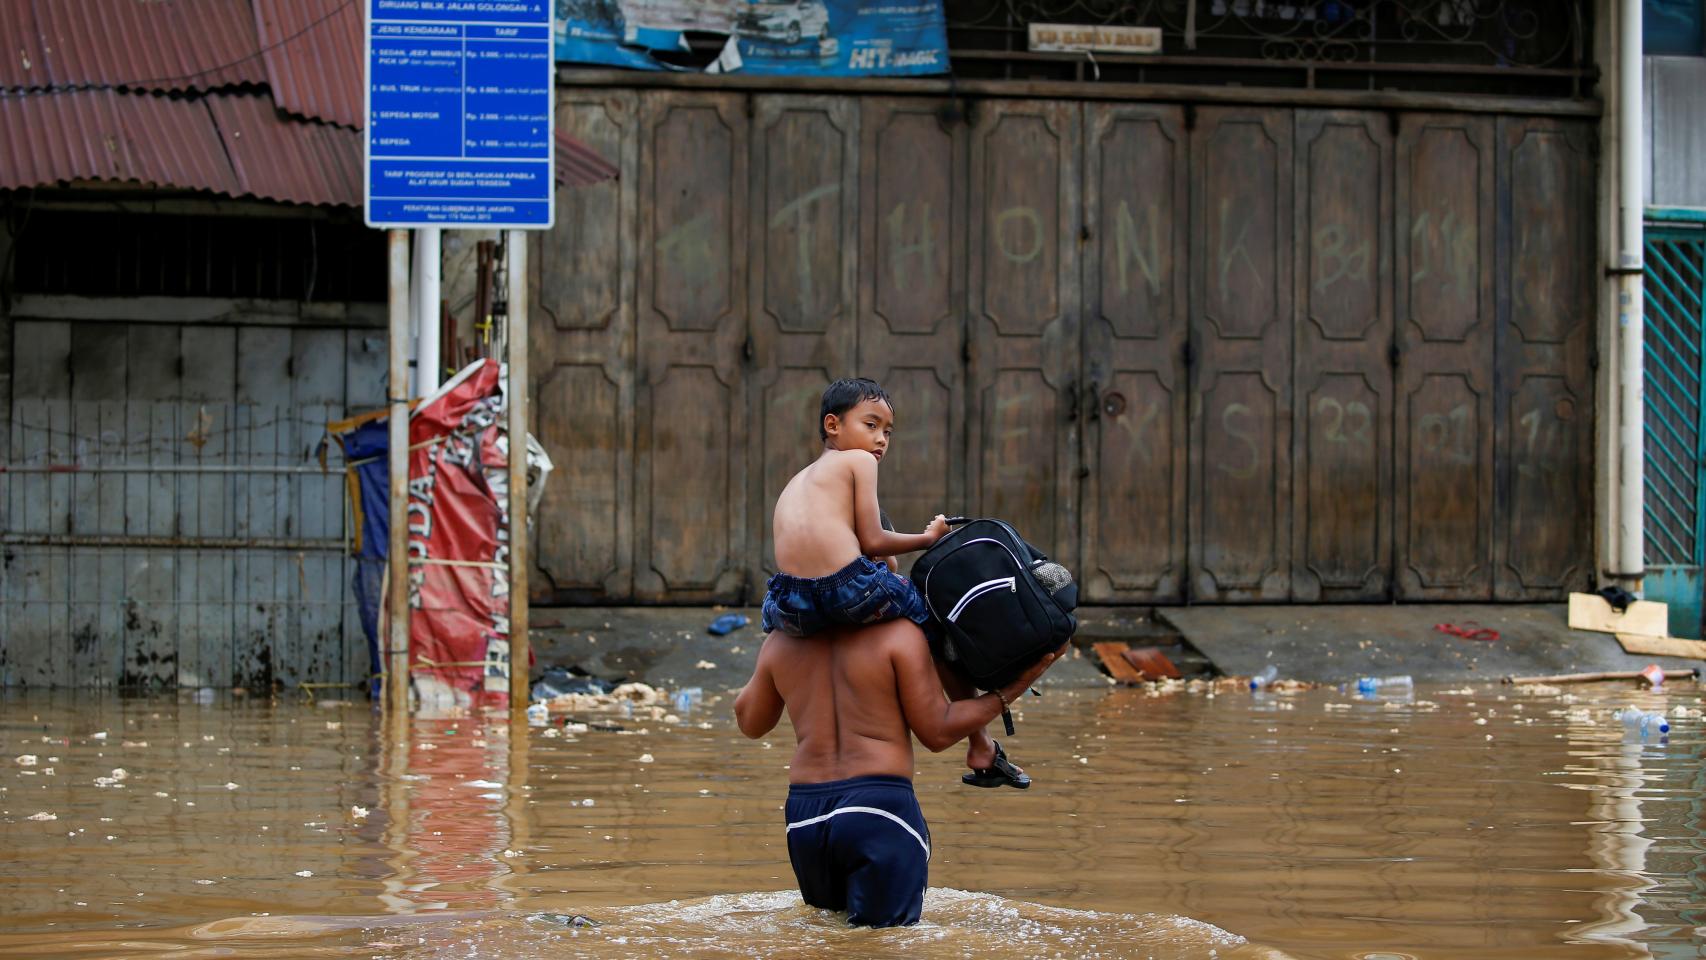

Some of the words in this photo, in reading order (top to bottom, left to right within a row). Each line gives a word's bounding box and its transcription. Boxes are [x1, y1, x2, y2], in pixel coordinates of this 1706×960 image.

[447, 3, 475, 11] JALAN
[477, 3, 528, 12] GOLONGAN
[378, 26, 402, 34] JENIS
[404, 26, 458, 35] KENDARAAN
[495, 28, 519, 36] TARIF
[400, 85, 420, 93] TRUK
[380, 111, 410, 119] SEPEDA
[379, 138, 411, 146] SEPEDA
[384, 170, 404, 178] TARIF
[405, 170, 445, 178] PROGRESIF
[456, 171, 504, 179] BERLAKUKAN
[505, 172, 535, 180] APABILA
[450, 179, 475, 187] SUDAH
[477, 179, 511, 187] TERSEDIA
[403, 204, 440, 212] PERATURAN
[441, 205, 474, 213] GUBERNUR
